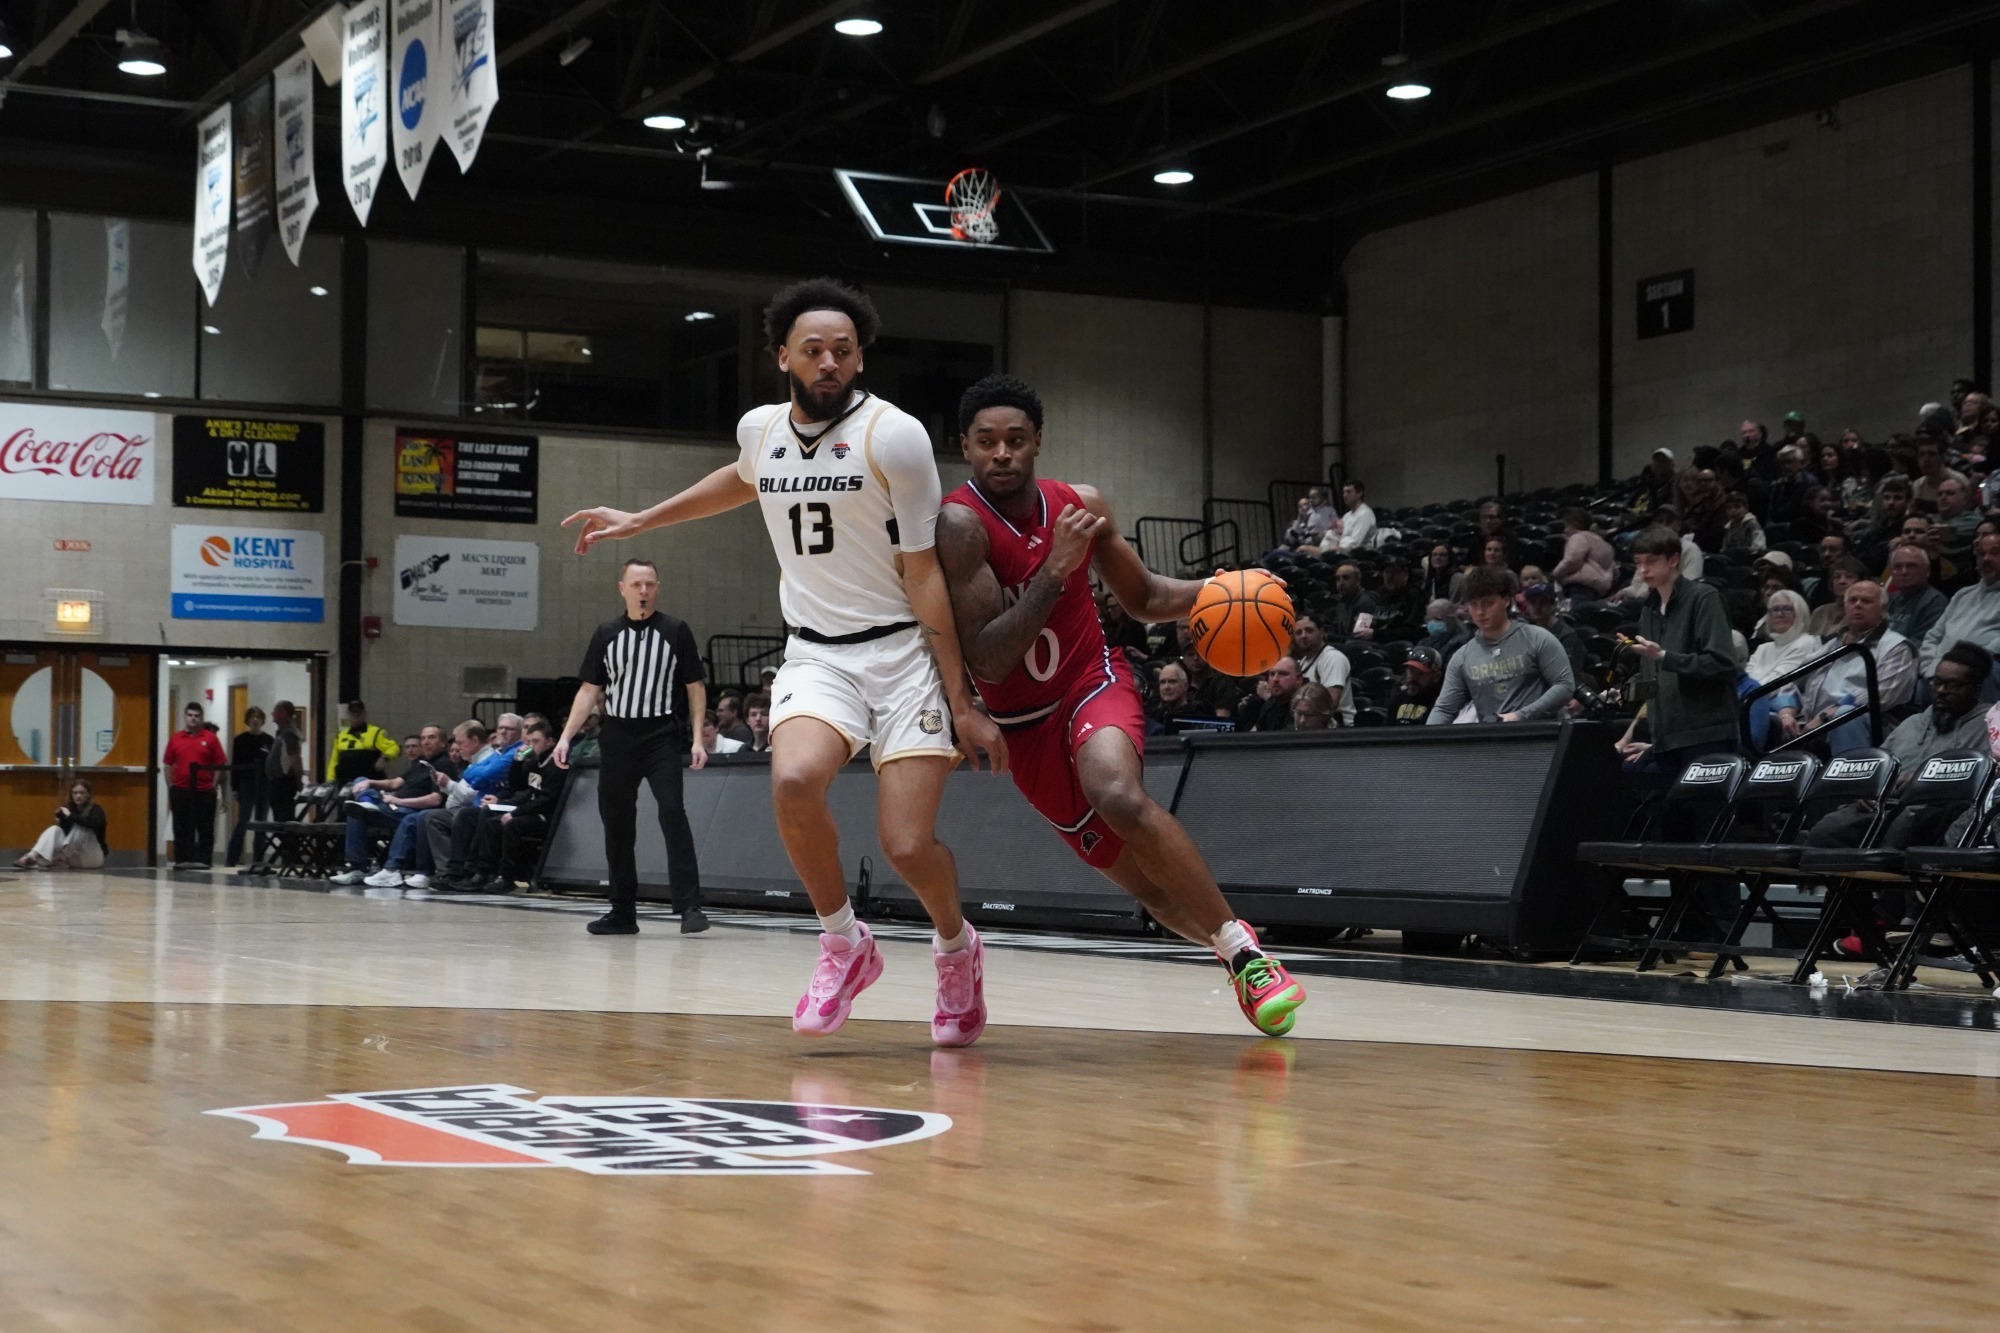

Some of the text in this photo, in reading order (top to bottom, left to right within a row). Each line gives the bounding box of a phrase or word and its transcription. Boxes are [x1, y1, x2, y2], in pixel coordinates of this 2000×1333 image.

[403, 141, 422, 171] 2018
[354, 177, 371, 205] 2018
[1661, 302, 1669, 329] 1
[206, 419, 299, 433] AKIM'S TAILORING
[219, 429, 241, 438] DRY
[244, 430, 297, 441] CLEANING
[0, 428, 149, 479] Coca-Cola
[458, 441, 530, 456] THE LAST RESORT
[830, 446, 851, 454] AMERICA
[759, 475, 864, 493] BULLDOGS
[788, 502, 834, 555] 13
[234, 537, 295, 557] KENT
[234, 558, 295, 570] HOSPITAL
[461, 553, 527, 567] MAC'S LIQUOR
[480, 567, 507, 577] MART
[1024, 627, 1060, 682] 0
[1470, 654, 1525, 681] BRYANT
[1684, 765, 1731, 781] BRYANT
[1752, 763, 1801, 779] BRYANT
[1825, 760, 1879, 777] BRYANT
[1922, 761, 1976, 778] BRYANT
[1297, 887, 1332, 895] DAKTRONICS
[982, 902, 1016, 911] DAKTRONICS
